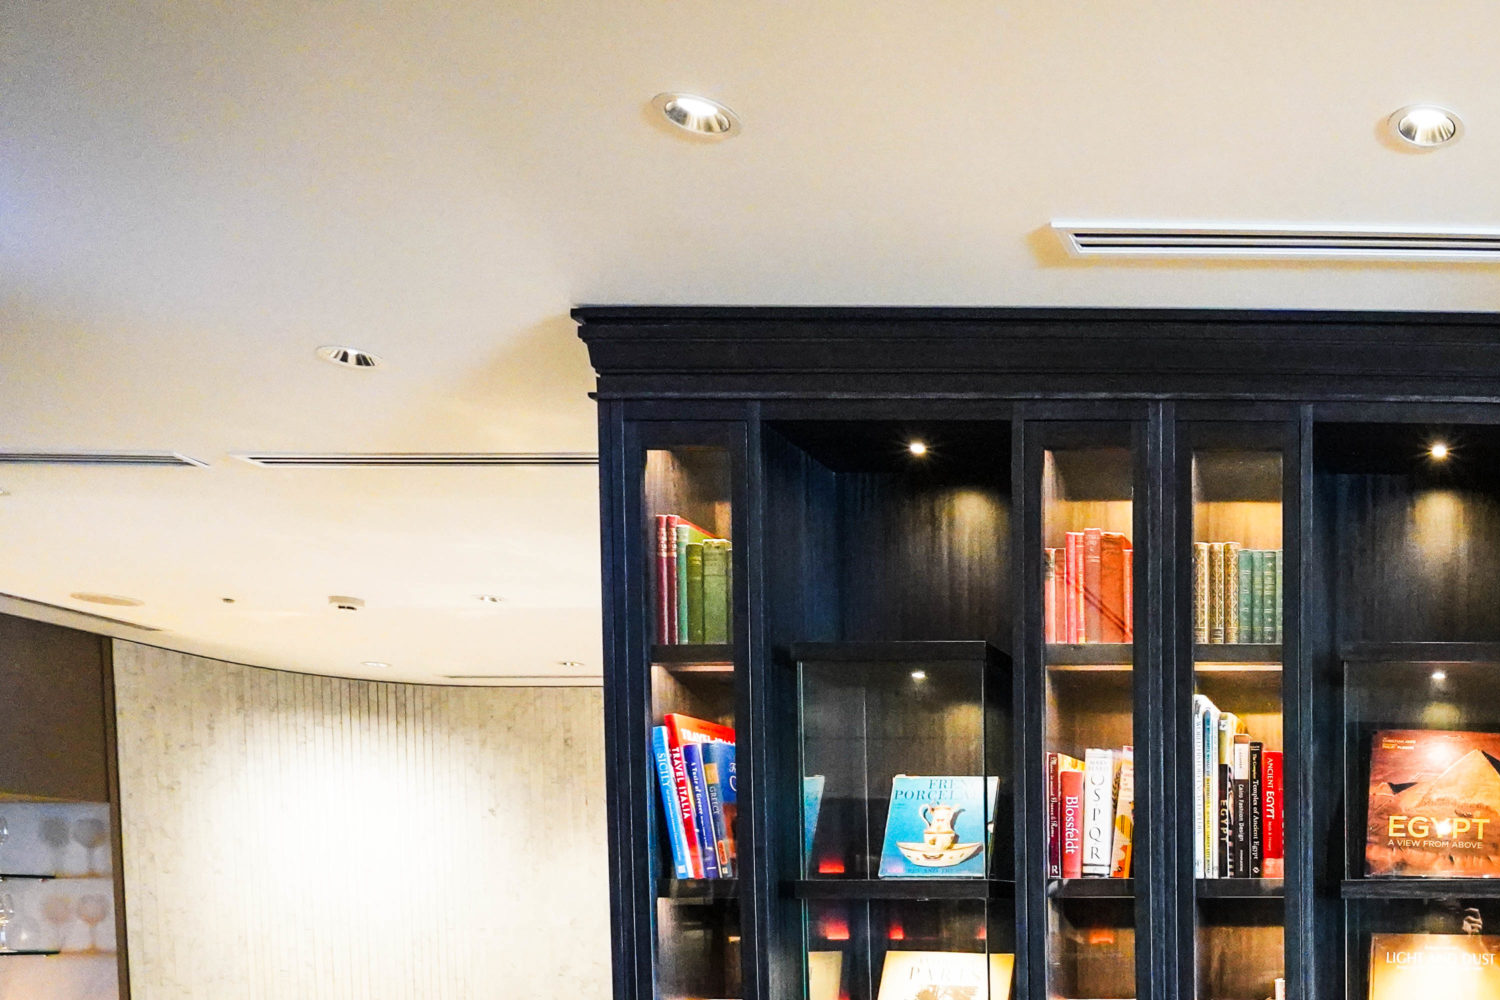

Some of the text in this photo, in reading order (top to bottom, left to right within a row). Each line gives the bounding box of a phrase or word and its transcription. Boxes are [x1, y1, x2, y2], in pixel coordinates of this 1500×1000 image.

[657, 752, 671, 787] SICILY
[671, 747, 685, 783] TRAVEL
[678, 785, 691, 819] ITALIA
[1252, 780, 1260, 806] Temples
[1265, 757, 1275, 819] ANCIENT EGYPT
[1065, 796, 1079, 854] Blossfeldt
[1220, 799, 1228, 843] EGYPT
[1252, 815, 1260, 839] Ancient
[1388, 815, 1490, 840] EGYPT
[1251, 841, 1260, 860] Egypt
[1423, 840, 1449, 848] FROM
[1451, 841, 1483, 849] ABOVE
[1386, 951, 1422, 964] LIGHT
[1462, 953, 1496, 965] DUST
